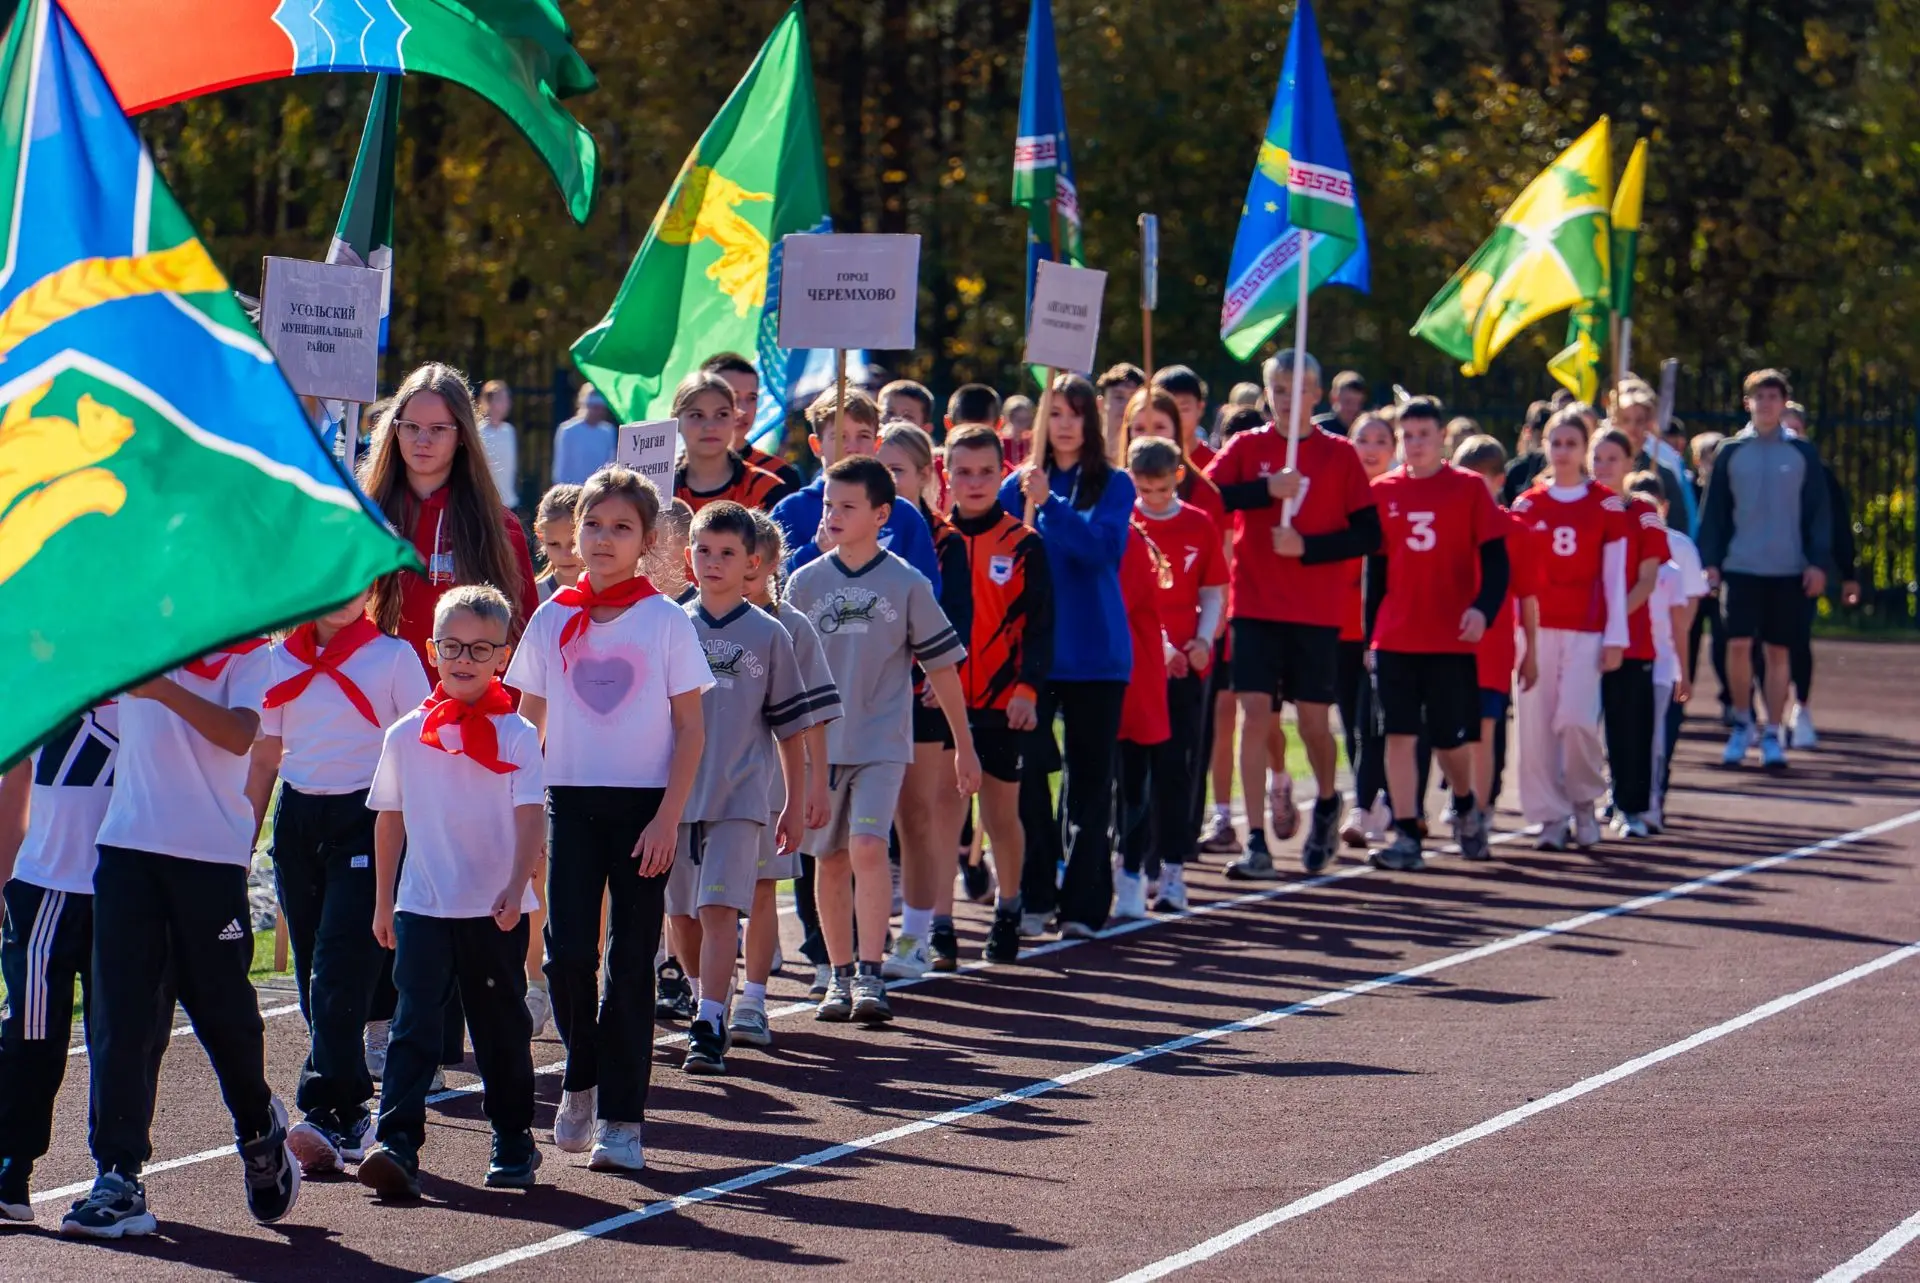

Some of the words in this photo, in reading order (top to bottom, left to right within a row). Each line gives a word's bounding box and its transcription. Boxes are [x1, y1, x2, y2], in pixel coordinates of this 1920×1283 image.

[836, 272, 870, 283] ГОРОД
[807, 287, 896, 301] ЧЕРЕМХОВО
[290, 302, 357, 321] УСОЛЬСКИЙ
[280, 322, 364, 340] МУНИЦИПАЛЬНЫЙ
[307, 340, 336, 354] РАЙОН
[632, 434, 666, 455] Ураган
[1405, 511, 1437, 552] 3
[1551, 526, 1578, 557] 8
[807, 587, 898, 624] CHAMPIONS
[700, 639, 764, 679] MPIONS
